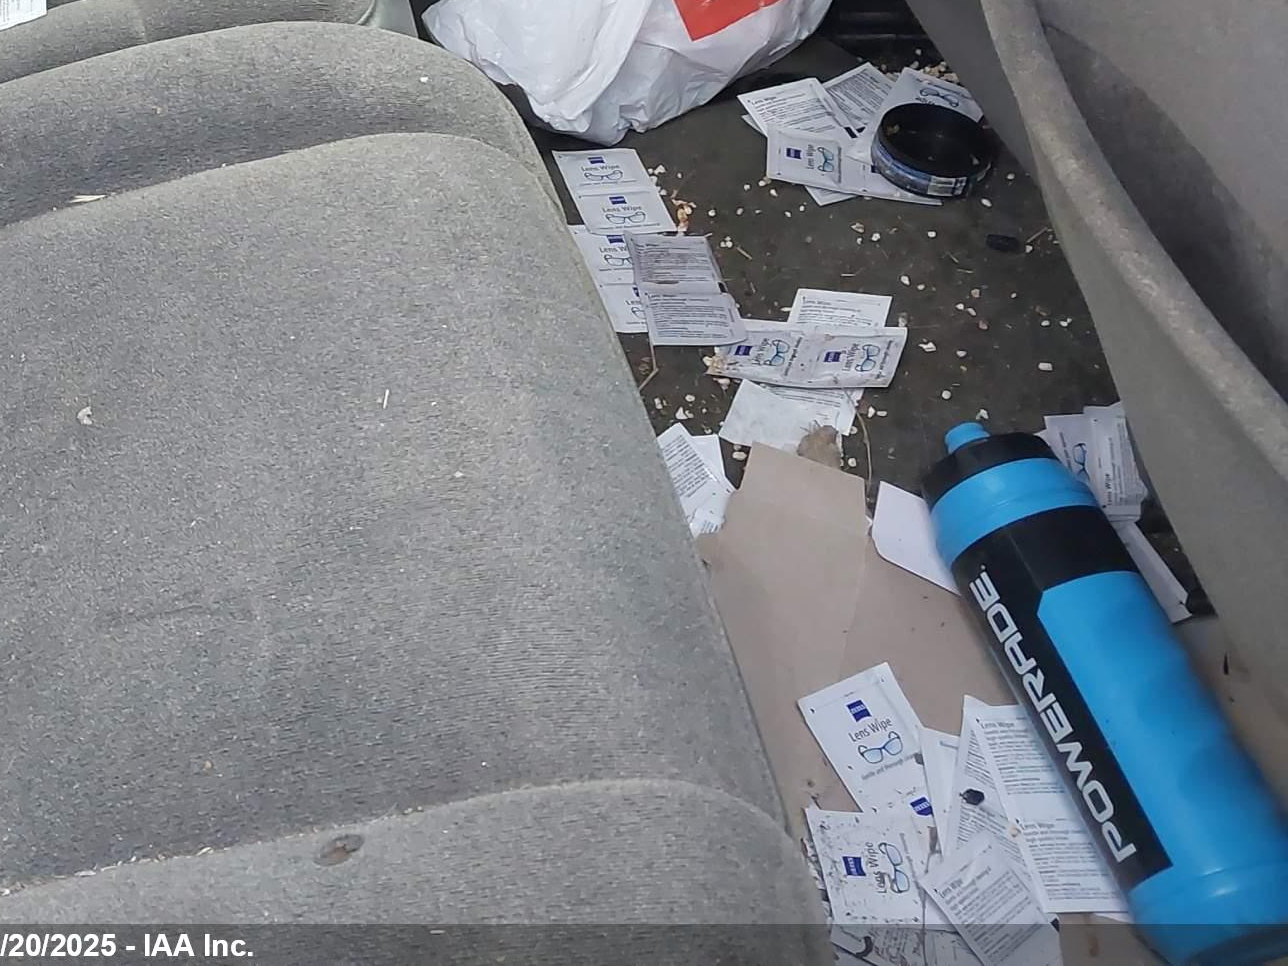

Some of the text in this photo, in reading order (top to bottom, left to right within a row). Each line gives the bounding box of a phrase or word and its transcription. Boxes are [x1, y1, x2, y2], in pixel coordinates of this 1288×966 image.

[848, 717, 893, 742] Lens Wipe
[969, 571, 1138, 863] POWERADE
